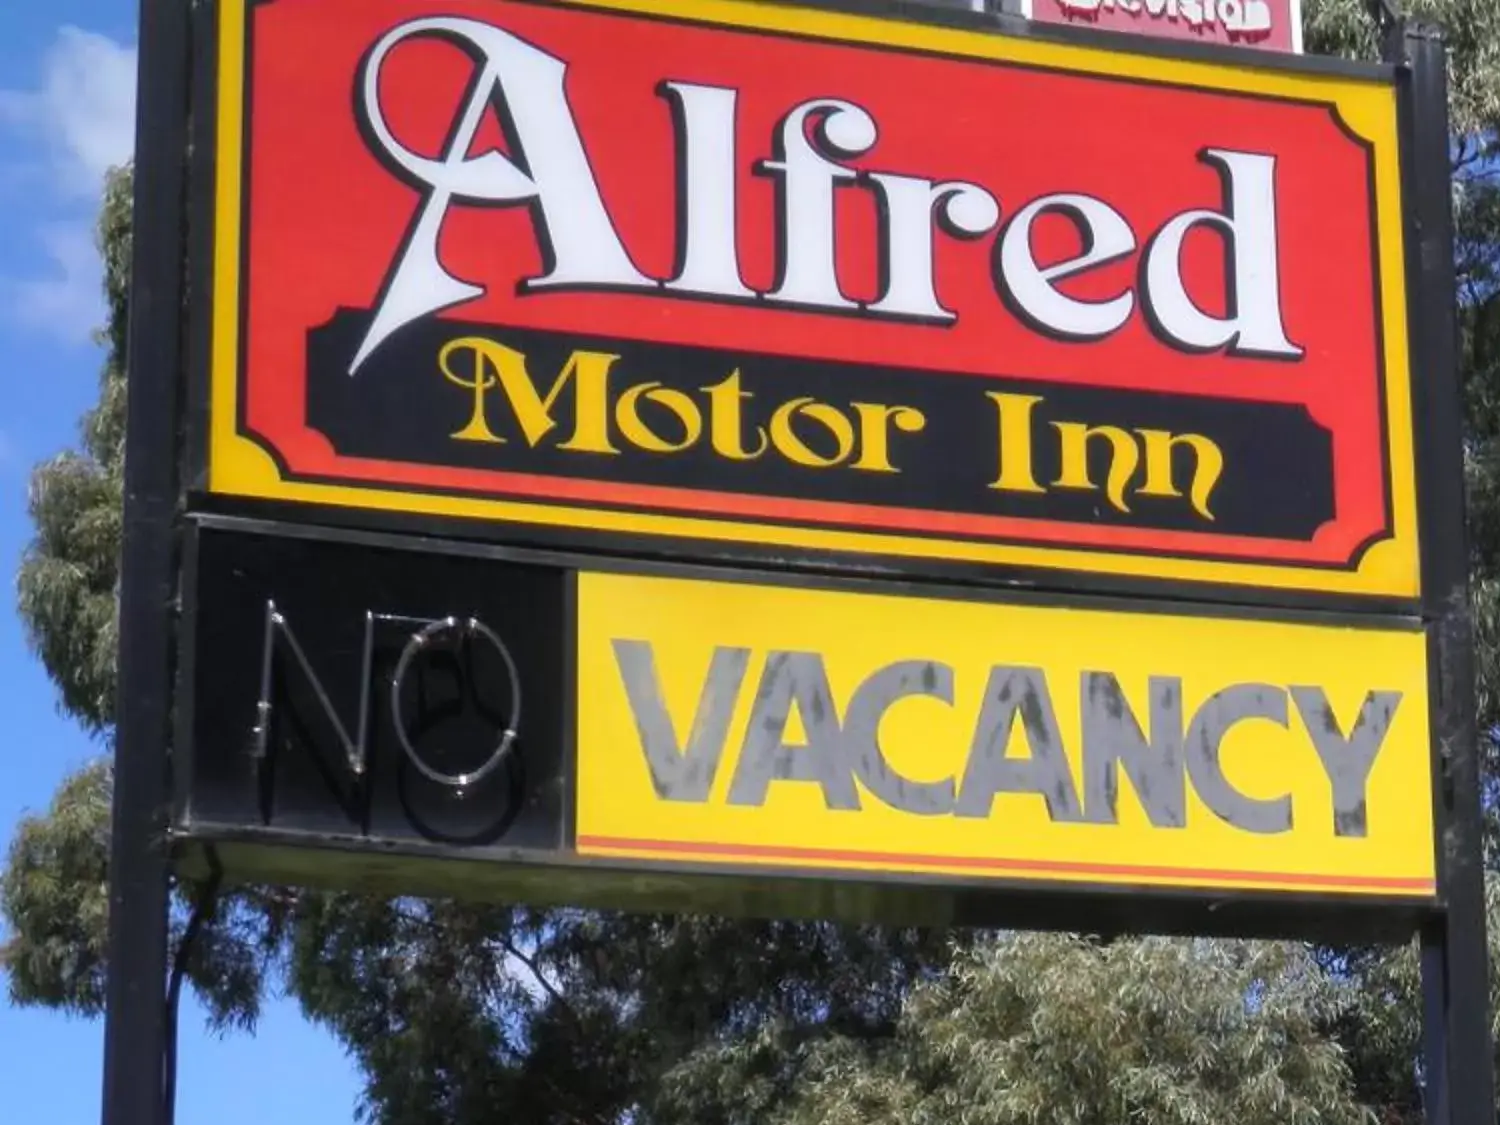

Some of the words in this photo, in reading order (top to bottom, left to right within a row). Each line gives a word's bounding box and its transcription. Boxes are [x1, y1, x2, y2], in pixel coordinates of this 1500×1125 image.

[348, 15, 1306, 376] Alfred
[439, 336, 926, 474] Motor
[985, 391, 1225, 521] Inn
[250, 598, 524, 792] NO
[612, 638, 1402, 839] VACANCY
